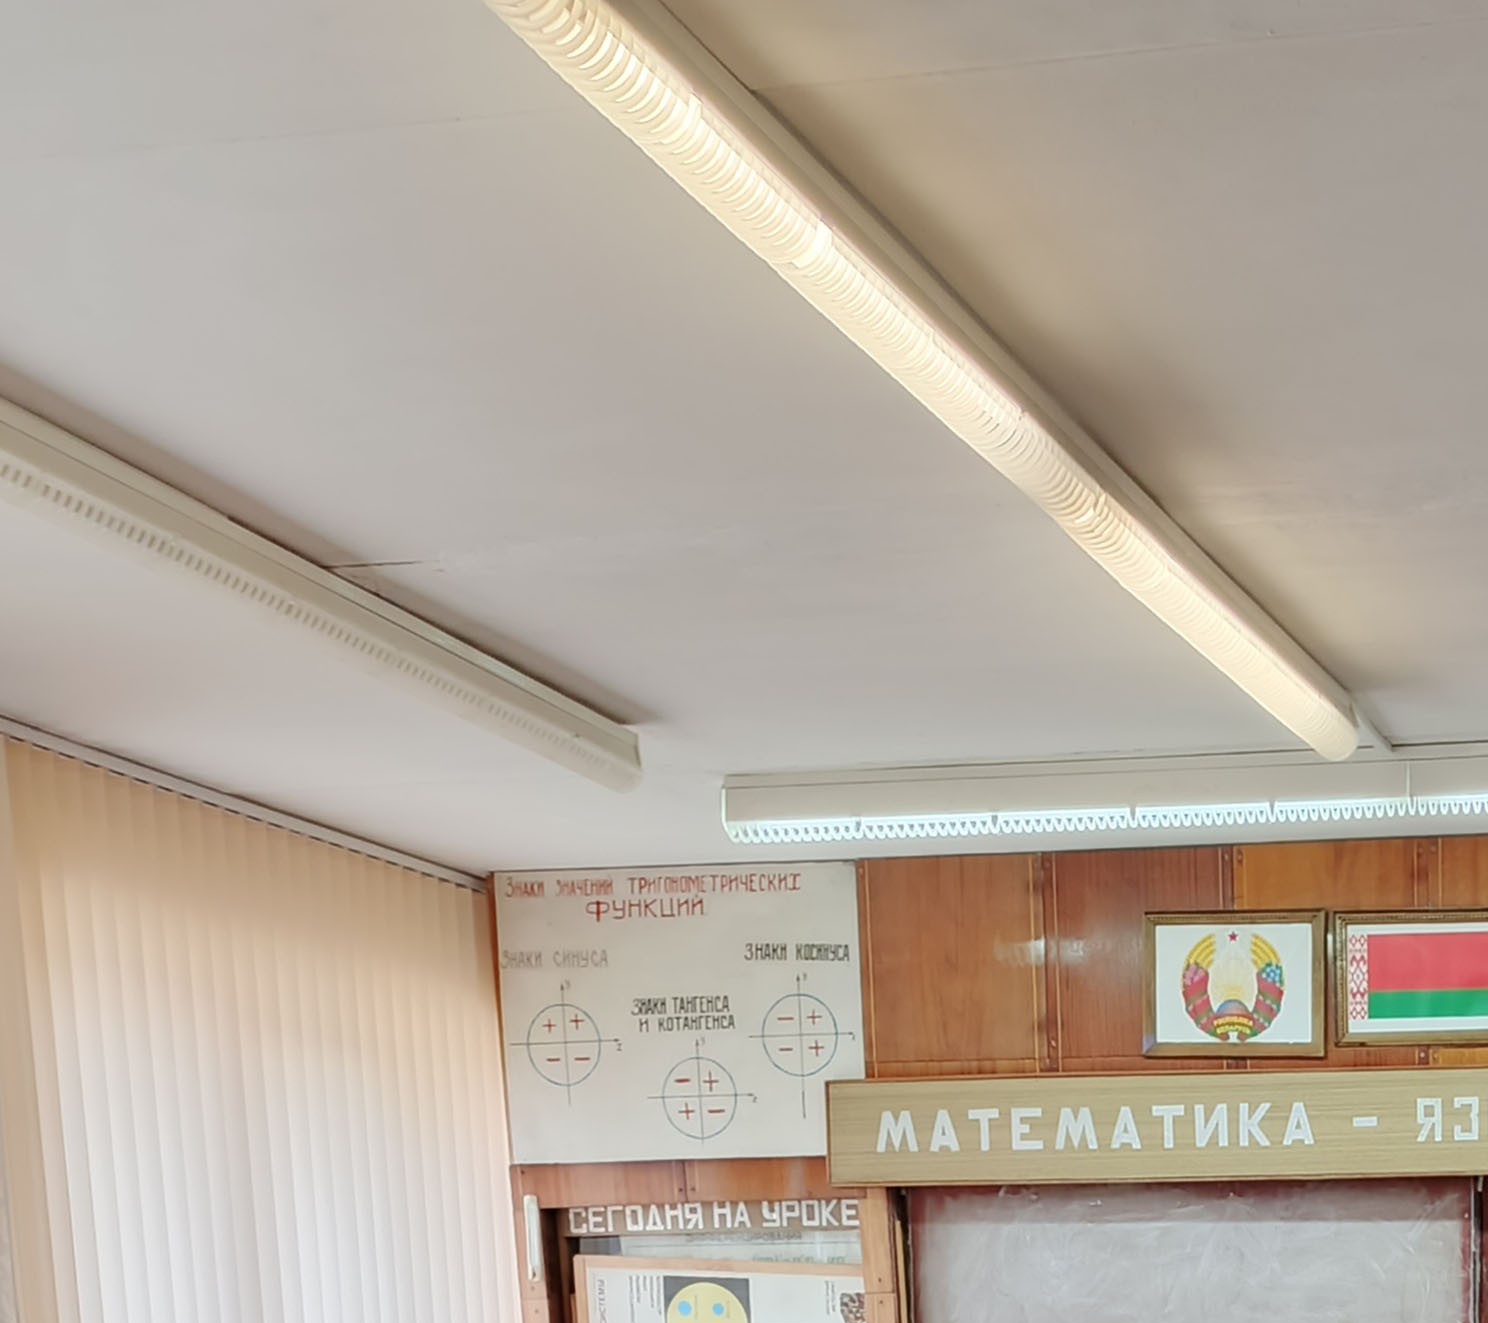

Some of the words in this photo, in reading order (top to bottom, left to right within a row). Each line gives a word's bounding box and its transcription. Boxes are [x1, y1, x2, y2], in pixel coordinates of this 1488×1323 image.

[627, 872, 801, 895] ТРИГОНОМЕТРИЧЕСКИХ
[585, 893, 705, 923] ФУНКЦИЙ
[744, 943, 788, 962] ЗНАКИ
[672, 995, 731, 1014] ТАНГЕНСА
[657, 1014, 736, 1033] КОТАНГЕНСА
[876, 1102, 1315, 1153] МАТЕМАТИКА
[569, 1202, 704, 1234] СЕГОДНЯ
[713, 1200, 751, 1230] НА
[762, 1199, 860, 1229] УРОКЕ
